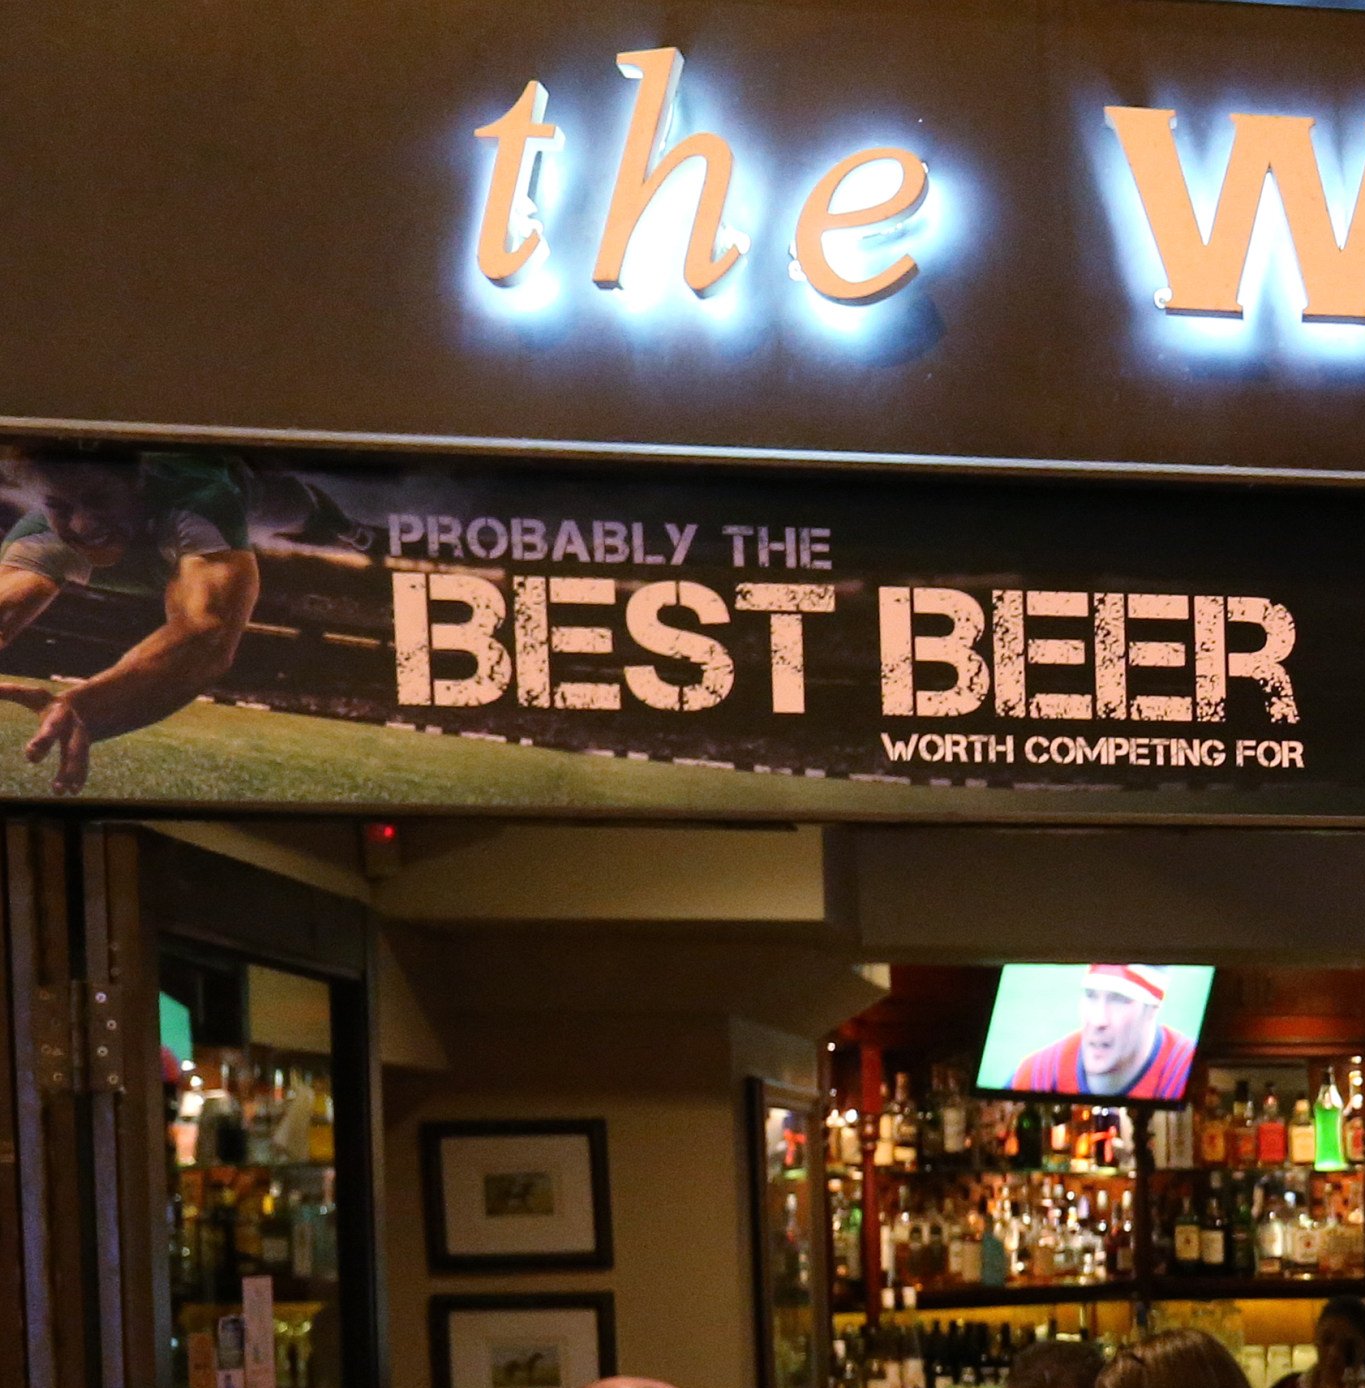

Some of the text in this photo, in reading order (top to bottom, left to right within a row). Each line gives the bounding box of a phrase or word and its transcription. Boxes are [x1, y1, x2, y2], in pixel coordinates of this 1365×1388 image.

[474, 46, 932, 304] the
[388, 513, 833, 570] PROBABLY THE
[391, 572, 1300, 724] BEST BEER
[880, 732, 1305, 769] WORTH COMPETING FOR
